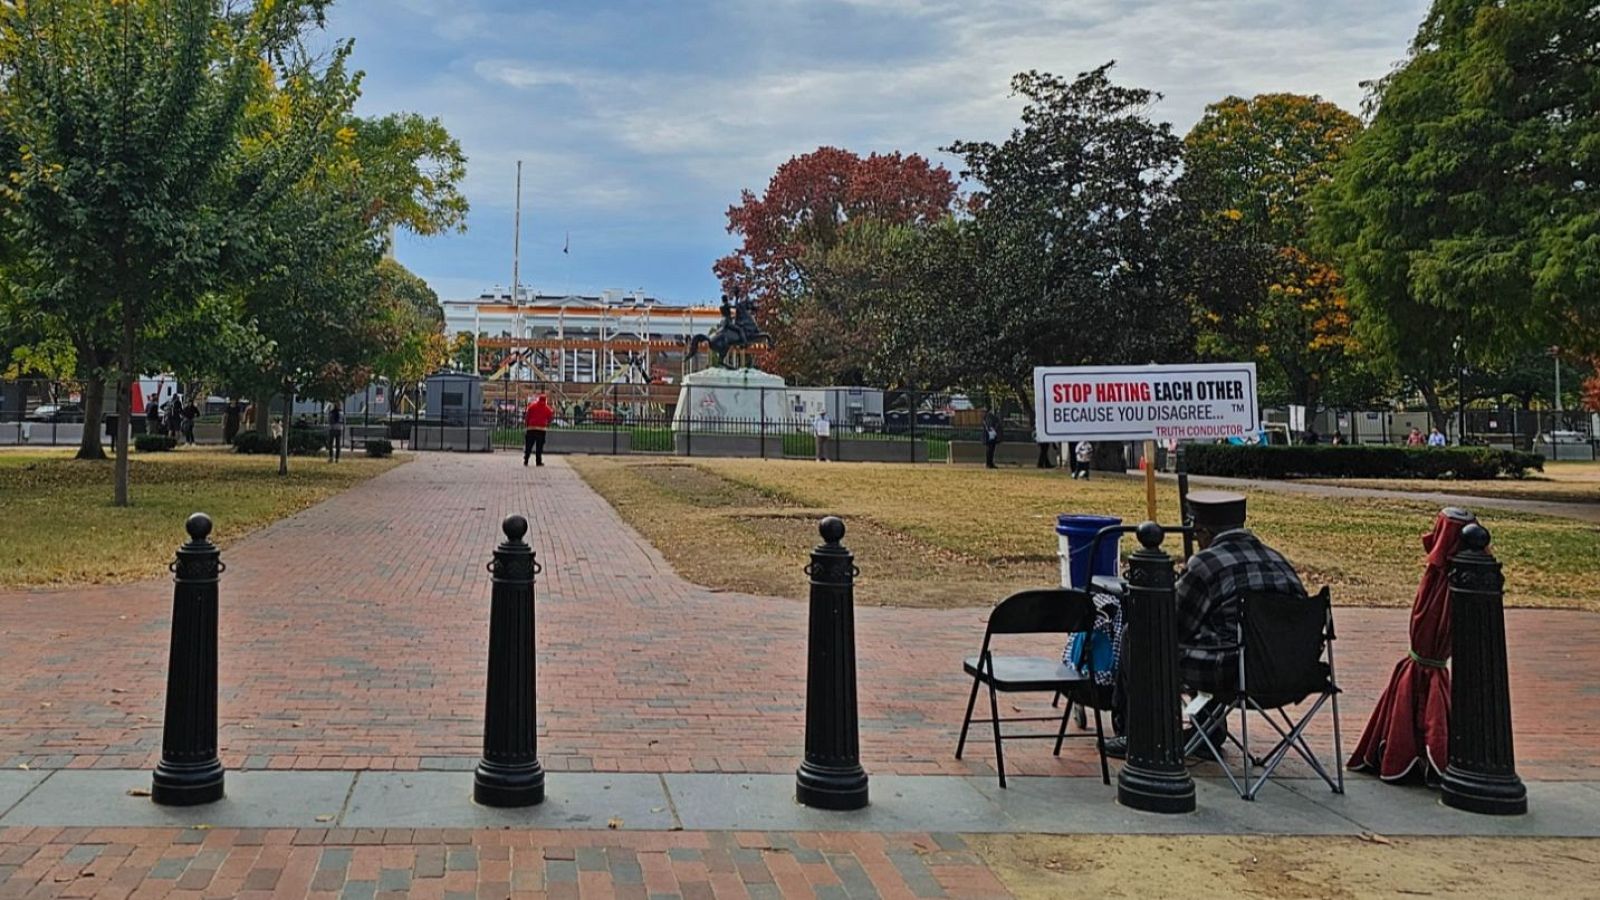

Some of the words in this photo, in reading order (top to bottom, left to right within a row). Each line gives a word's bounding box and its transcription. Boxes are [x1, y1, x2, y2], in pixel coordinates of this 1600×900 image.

[1053, 383, 1091, 403] STOP
[1096, 382, 1150, 402] HATING
[1155, 381, 1193, 401] EACH
[1197, 380, 1243, 400] OTHER
[1053, 406, 1113, 423] BECAUSE
[1118, 405, 1144, 421] YOU
[1148, 404, 1224, 421] DISAGREE...
[1232, 403, 1244, 412] TM
[1155, 426, 1185, 437] TRUTH
[1187, 425, 1243, 436] CONDUCTOR
